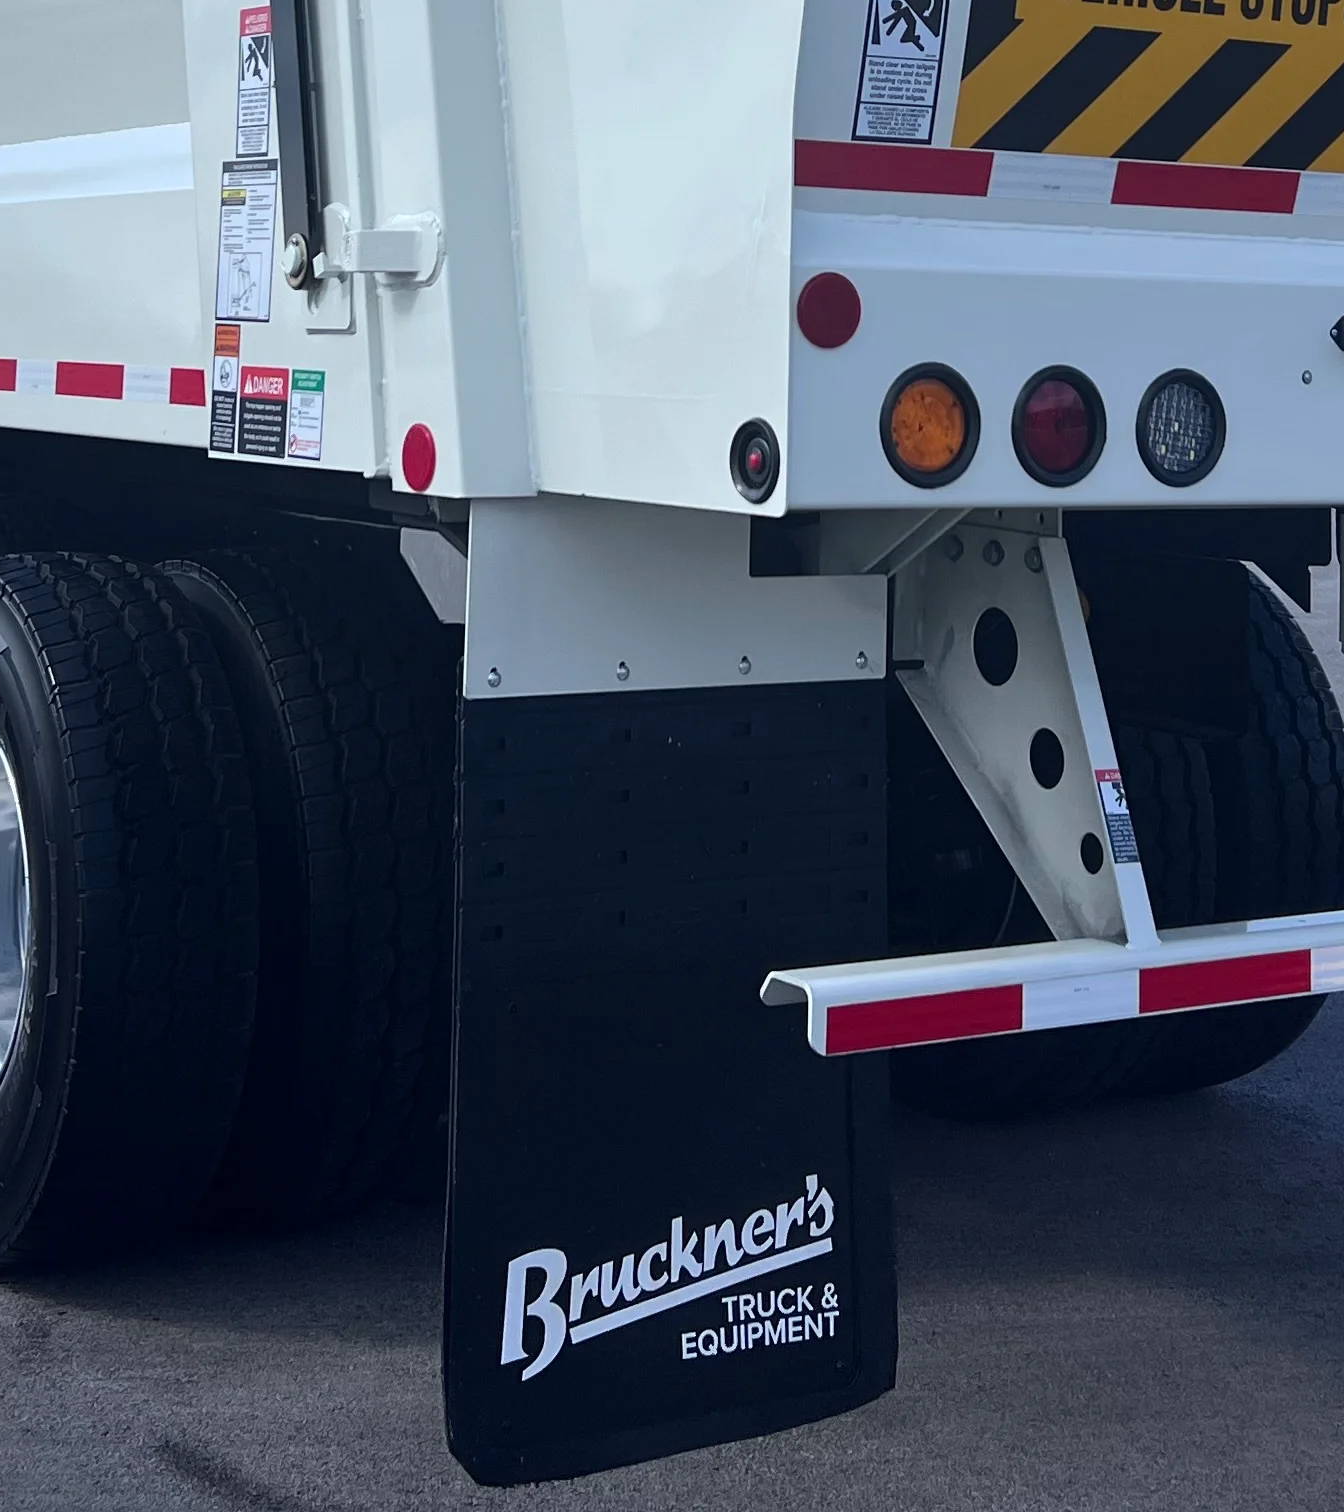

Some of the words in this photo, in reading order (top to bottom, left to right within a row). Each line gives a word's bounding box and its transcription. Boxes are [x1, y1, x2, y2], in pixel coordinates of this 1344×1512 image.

[501, 1173, 834, 1381] Bruckner's
[722, 1284, 813, 1323] TRUCK
[821, 1282, 839, 1309] &
[681, 1310, 840, 1360] EQUIPMENT
